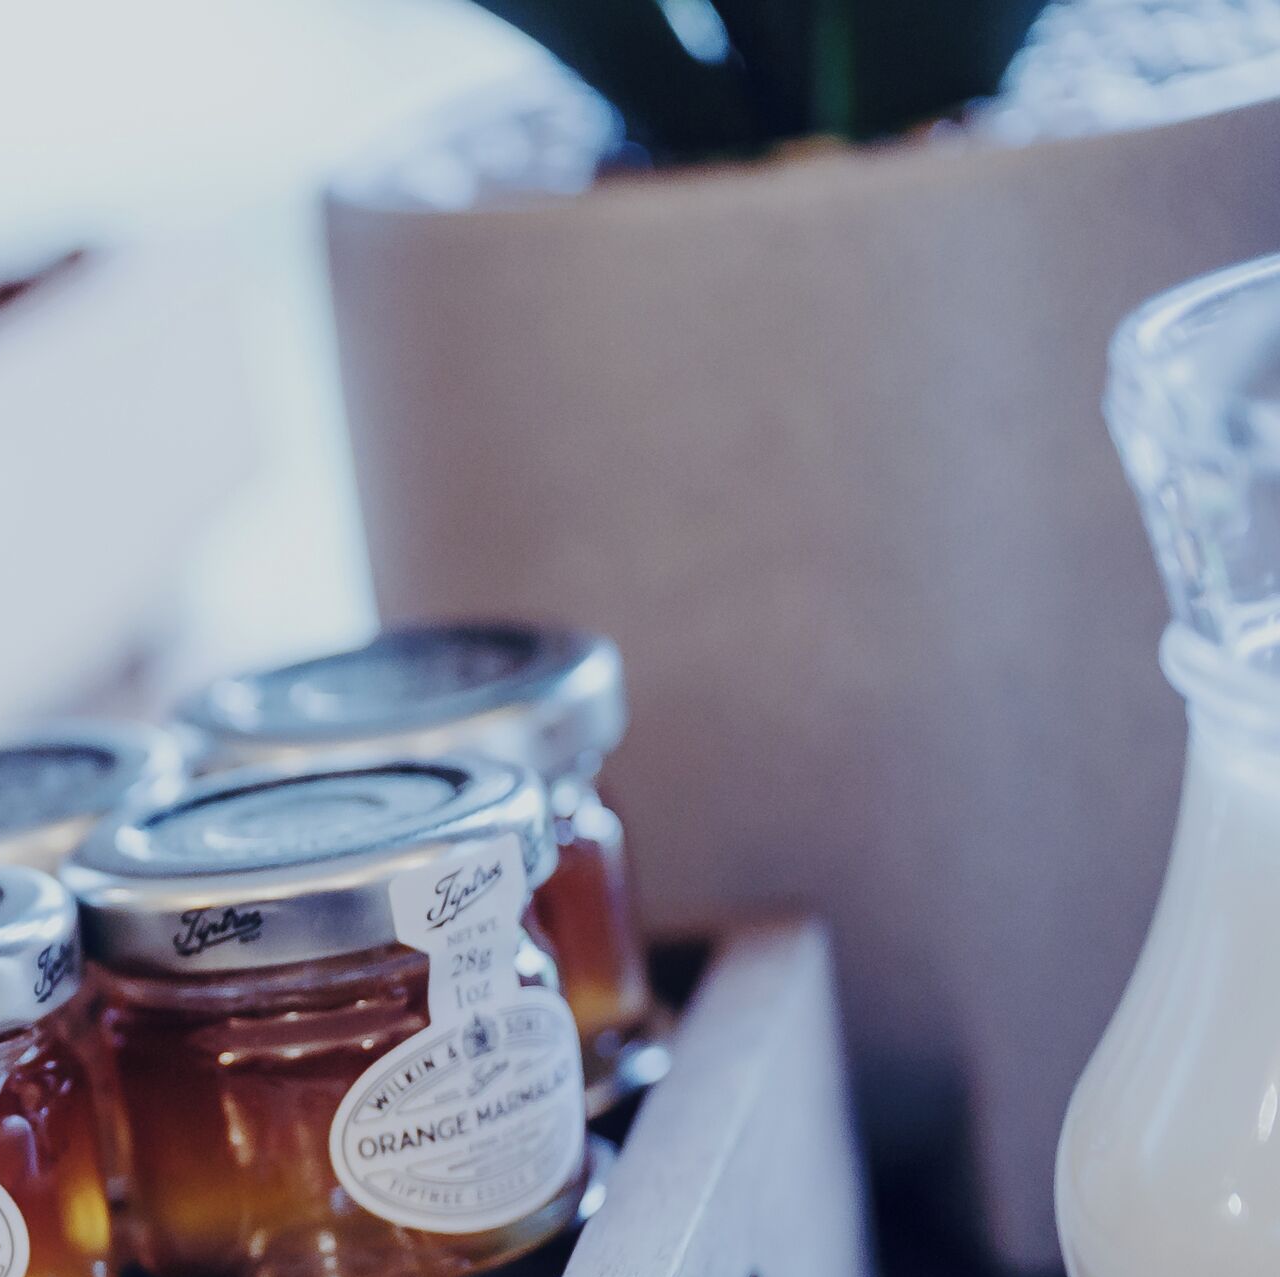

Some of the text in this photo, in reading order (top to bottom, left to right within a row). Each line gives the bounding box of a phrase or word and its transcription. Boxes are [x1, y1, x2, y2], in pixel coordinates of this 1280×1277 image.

[426, 860, 503, 931] Tiptree
[173, 906, 263, 957] Tiptree
[451, 947, 492, 978] 28g
[372, 1055, 436, 1111] WILKIN
[358, 1109, 471, 1160] ORANGE
